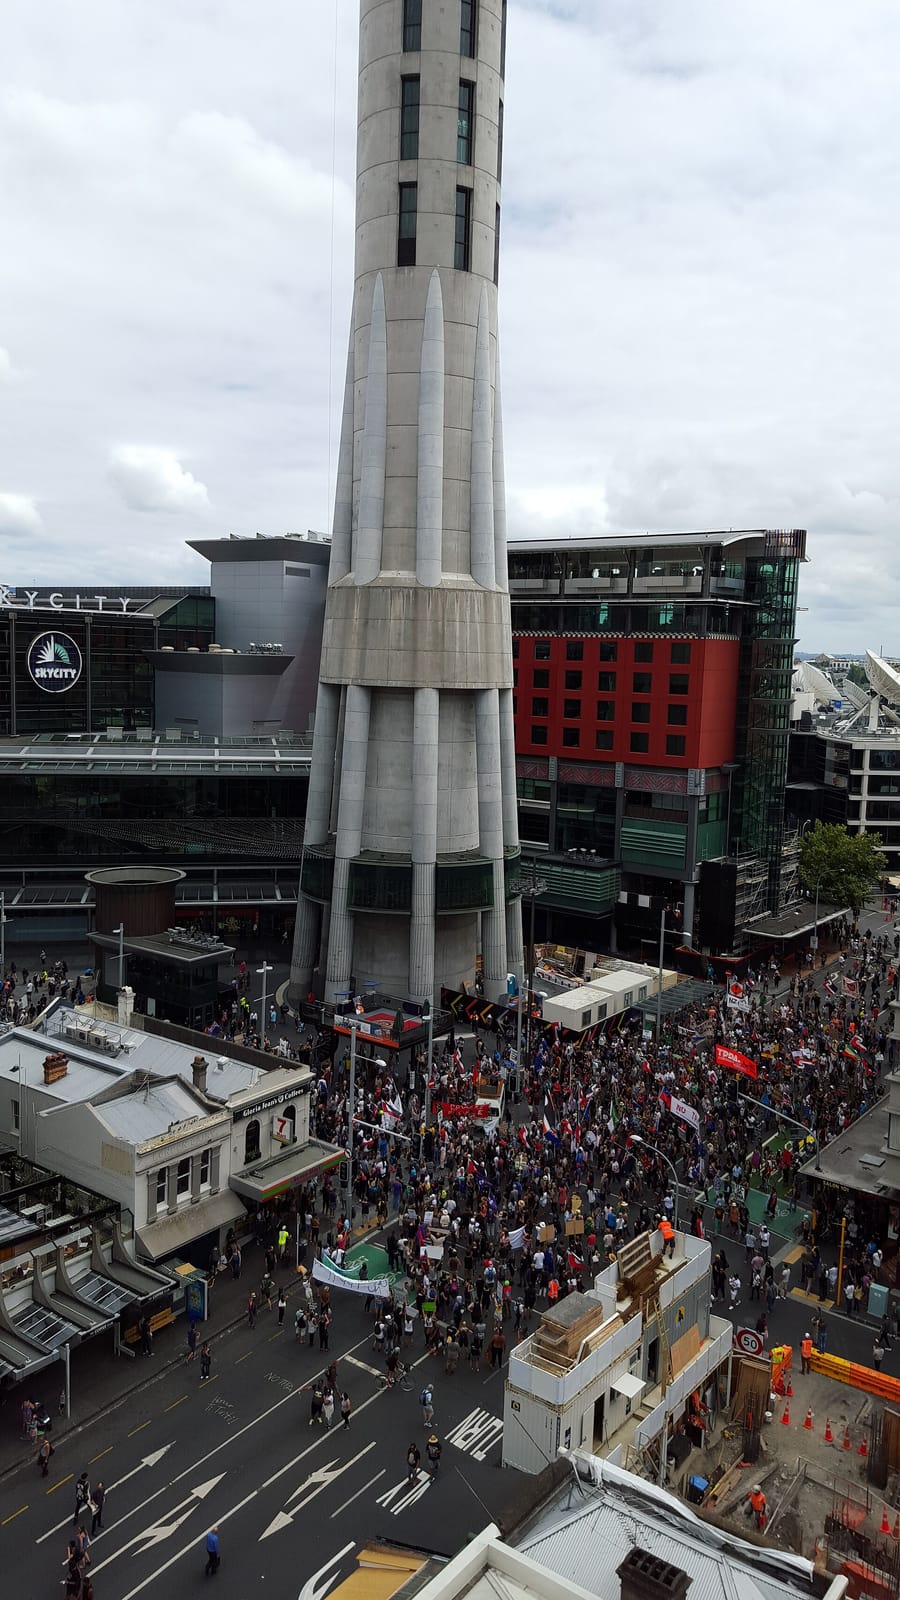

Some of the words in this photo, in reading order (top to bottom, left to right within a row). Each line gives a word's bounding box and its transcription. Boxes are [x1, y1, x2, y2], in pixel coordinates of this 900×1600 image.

[34, 667, 77, 679] SKYCITY
[242, 1104, 261, 1117] Gloria
[284, 1088, 304, 1100] Coffees
[743, 1335, 758, 1350] 50
